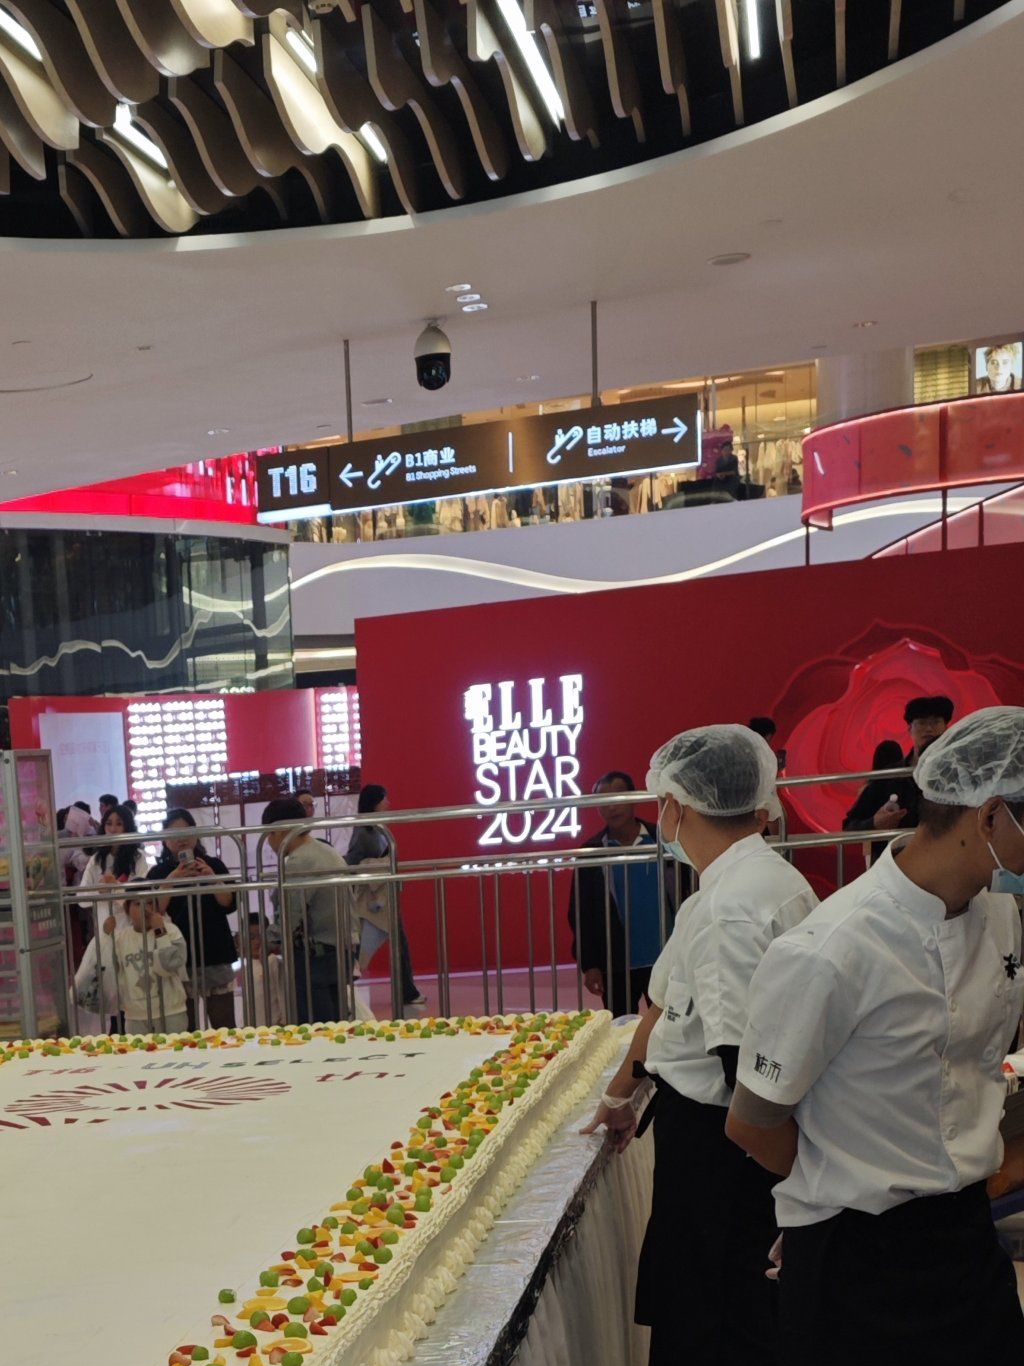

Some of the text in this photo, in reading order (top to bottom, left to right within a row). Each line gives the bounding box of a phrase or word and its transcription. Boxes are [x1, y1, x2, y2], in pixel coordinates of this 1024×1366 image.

[587, 418, 658, 444] 自动扶梯
[405, 446, 456, 468] B1商业
[588, 445, 626, 457] Escalator
[268, 462, 317, 498] T16
[405, 464, 477, 482] B1 Shopping Streets
[473, 723, 582, 764] BEAUTY
[474, 756, 582, 805] STAR
[477, 806, 582, 845] 2024
[219, 1052, 426, 1068] SELECT
